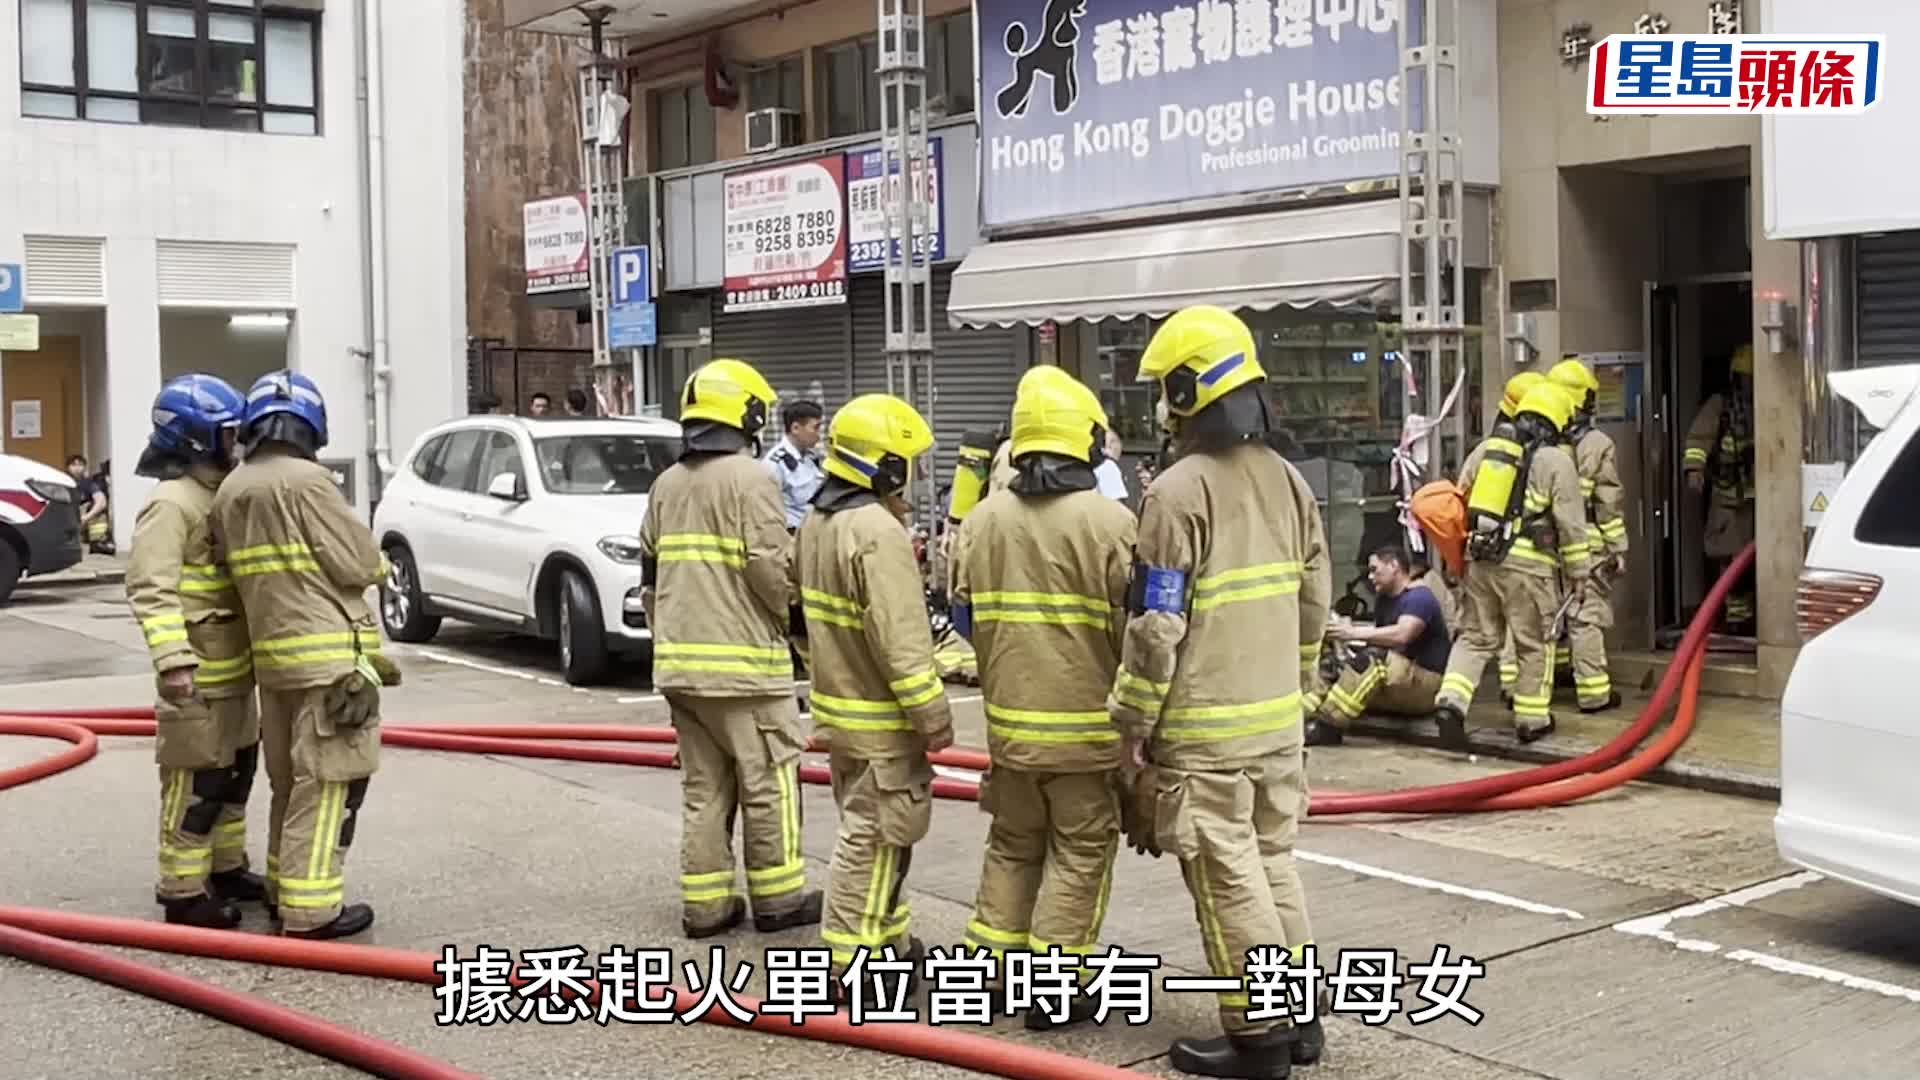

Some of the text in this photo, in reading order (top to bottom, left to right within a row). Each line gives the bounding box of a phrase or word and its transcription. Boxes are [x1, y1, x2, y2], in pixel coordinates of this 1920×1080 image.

[991, 75, 1400, 172] Hong Kong Doggie House
[1201, 127, 1412, 173] Professional Groomin
[755, 217, 791, 235] 6828
[797, 210, 834, 228] 7880
[755, 235, 791, 254] 9258
[797, 228, 835, 248] 8395
[619, 254, 641, 301] P
[777, 283, 808, 299] 2409
[811, 281, 842, 294] 0188
